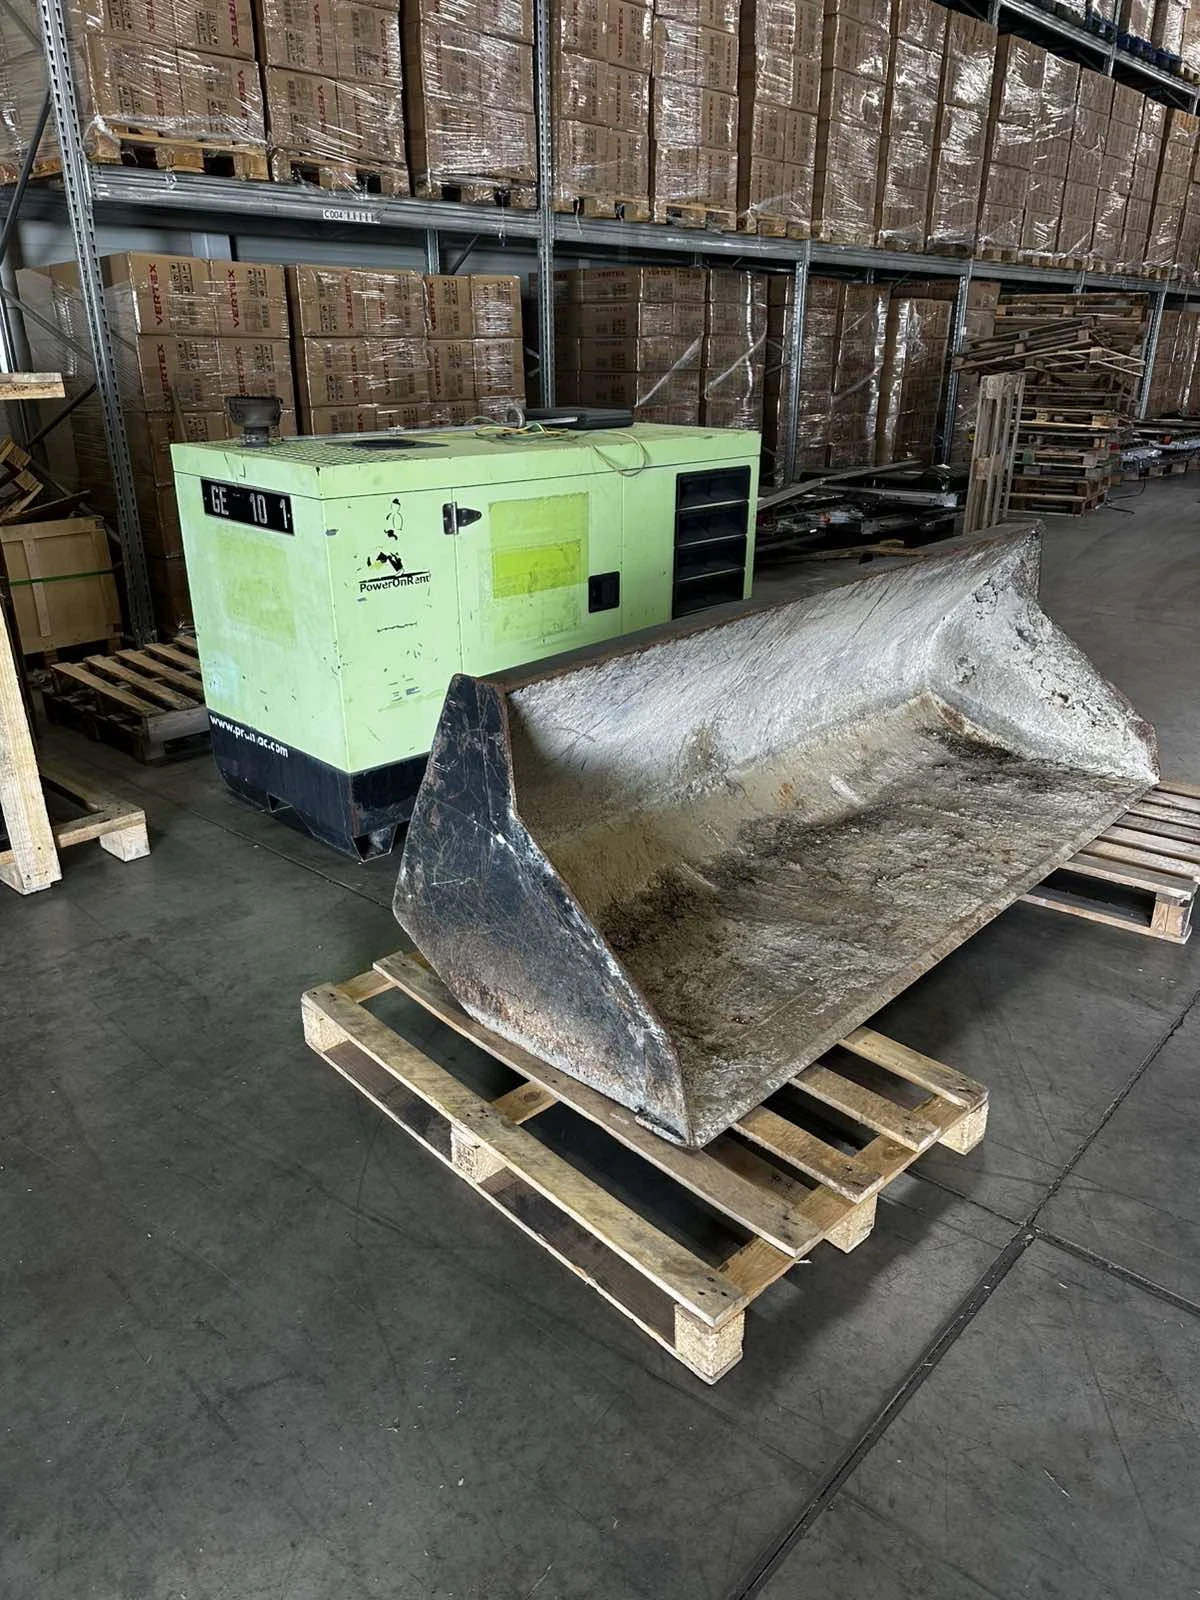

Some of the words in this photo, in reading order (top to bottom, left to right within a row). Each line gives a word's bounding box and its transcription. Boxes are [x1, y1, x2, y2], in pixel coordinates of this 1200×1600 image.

[148, 263, 163, 326] VERTEX
[227, 269, 240, 328] VERTEX
[428, 282, 437, 331] VERTEX
[157, 343, 170, 403] VERTEX
[235, 346, 246, 396] ERTEX
[350, 345, 359, 398] VEREX
[210, 485, 229, 515] GE
[249, 493, 268, 524] 10
[359, 574, 430, 593] PowerOnRent
